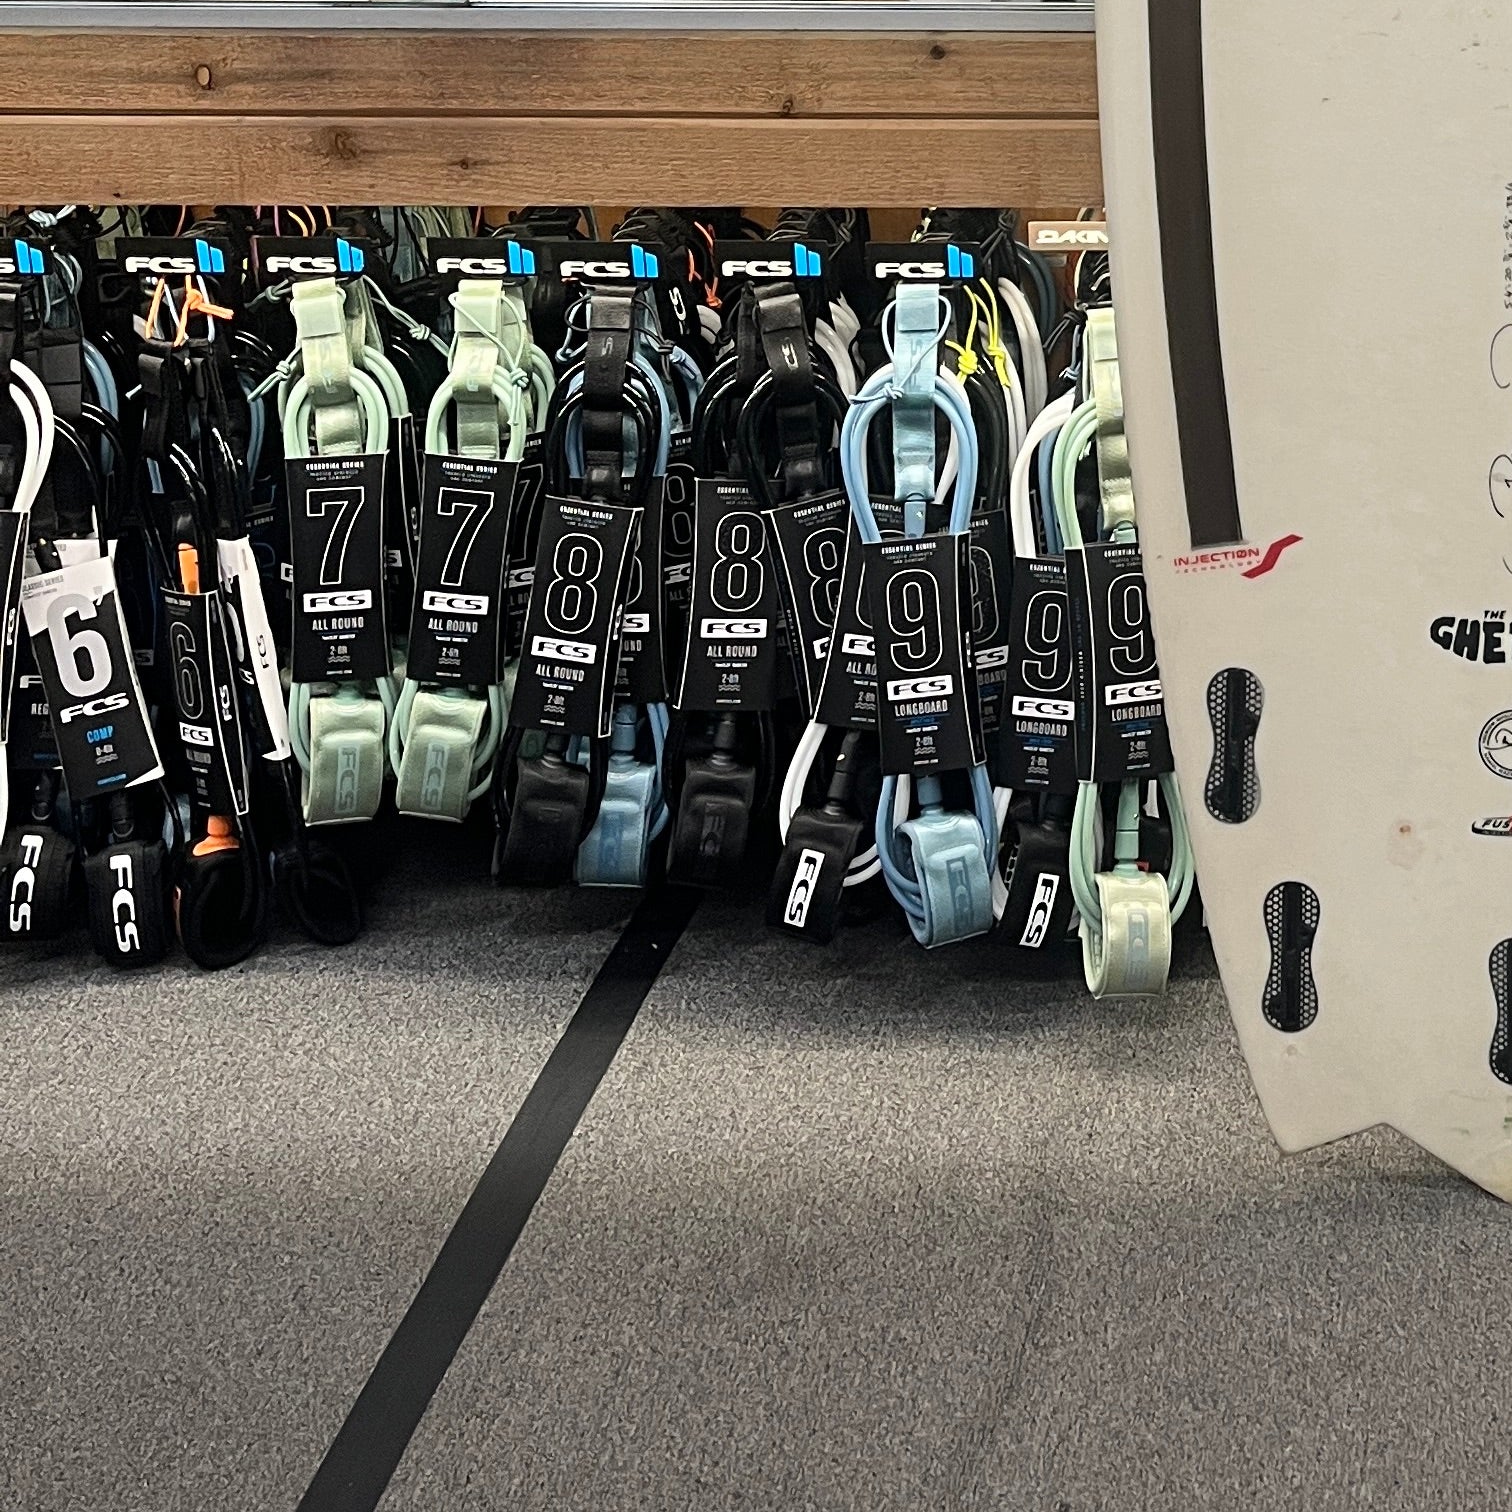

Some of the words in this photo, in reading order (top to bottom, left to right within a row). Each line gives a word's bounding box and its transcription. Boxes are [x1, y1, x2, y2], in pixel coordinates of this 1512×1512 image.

[125, 256, 197, 274] FCS
[266, 256, 338, 273] FCS
[436, 257, 508, 275] FCS
[560, 261, 631, 278] FCS
[721, 260, 793, 278] FCS
[875, 261, 946, 279] FCS
[306, 486, 364, 585] 7
[437, 486, 494, 587] 7
[710, 511, 765, 613] 8
[1173, 546, 1261, 567] INJECTION
[545, 533, 603, 634] 8
[309, 593, 365, 608] FCS
[428, 596, 485, 610] FCS
[311, 618, 328, 631] ALL
[331, 616, 365, 629] ROUND
[886, 568, 942, 671] 9
[1108, 572, 1158, 676] 9
[1484, 610, 1507, 623] THE
[428, 618, 444, 631] ALL
[447, 619, 479, 634] ROUND
[706, 621, 762, 635] FCS
[46, 592, 113, 698] 6
[537, 641, 592, 659] FCS
[1021, 590, 1073, 692] 9
[706, 645, 724, 658] ALL
[726, 644, 758, 658] ROUND
[170, 621, 203, 720] 6
[535, 664, 551, 678] ALL
[553, 665, 585, 682] ROUND
[893, 679, 947, 695] FCS
[1111, 685, 1161, 701] FCS
[59, 691, 130, 724] FCS
[895, 699, 948, 718] LONGBOARD
[1018, 701, 1070, 717] FCS
[1112, 703, 1162, 722] LONGBOARD
[86, 724, 114, 745] COMP
[1015, 719, 1068, 737] LONGBOARD
[9, 834, 45, 932] FCS
[785, 854, 822, 924] FCS
[109, 854, 140, 953] FCS
[1021, 877, 1057, 946] FCS
